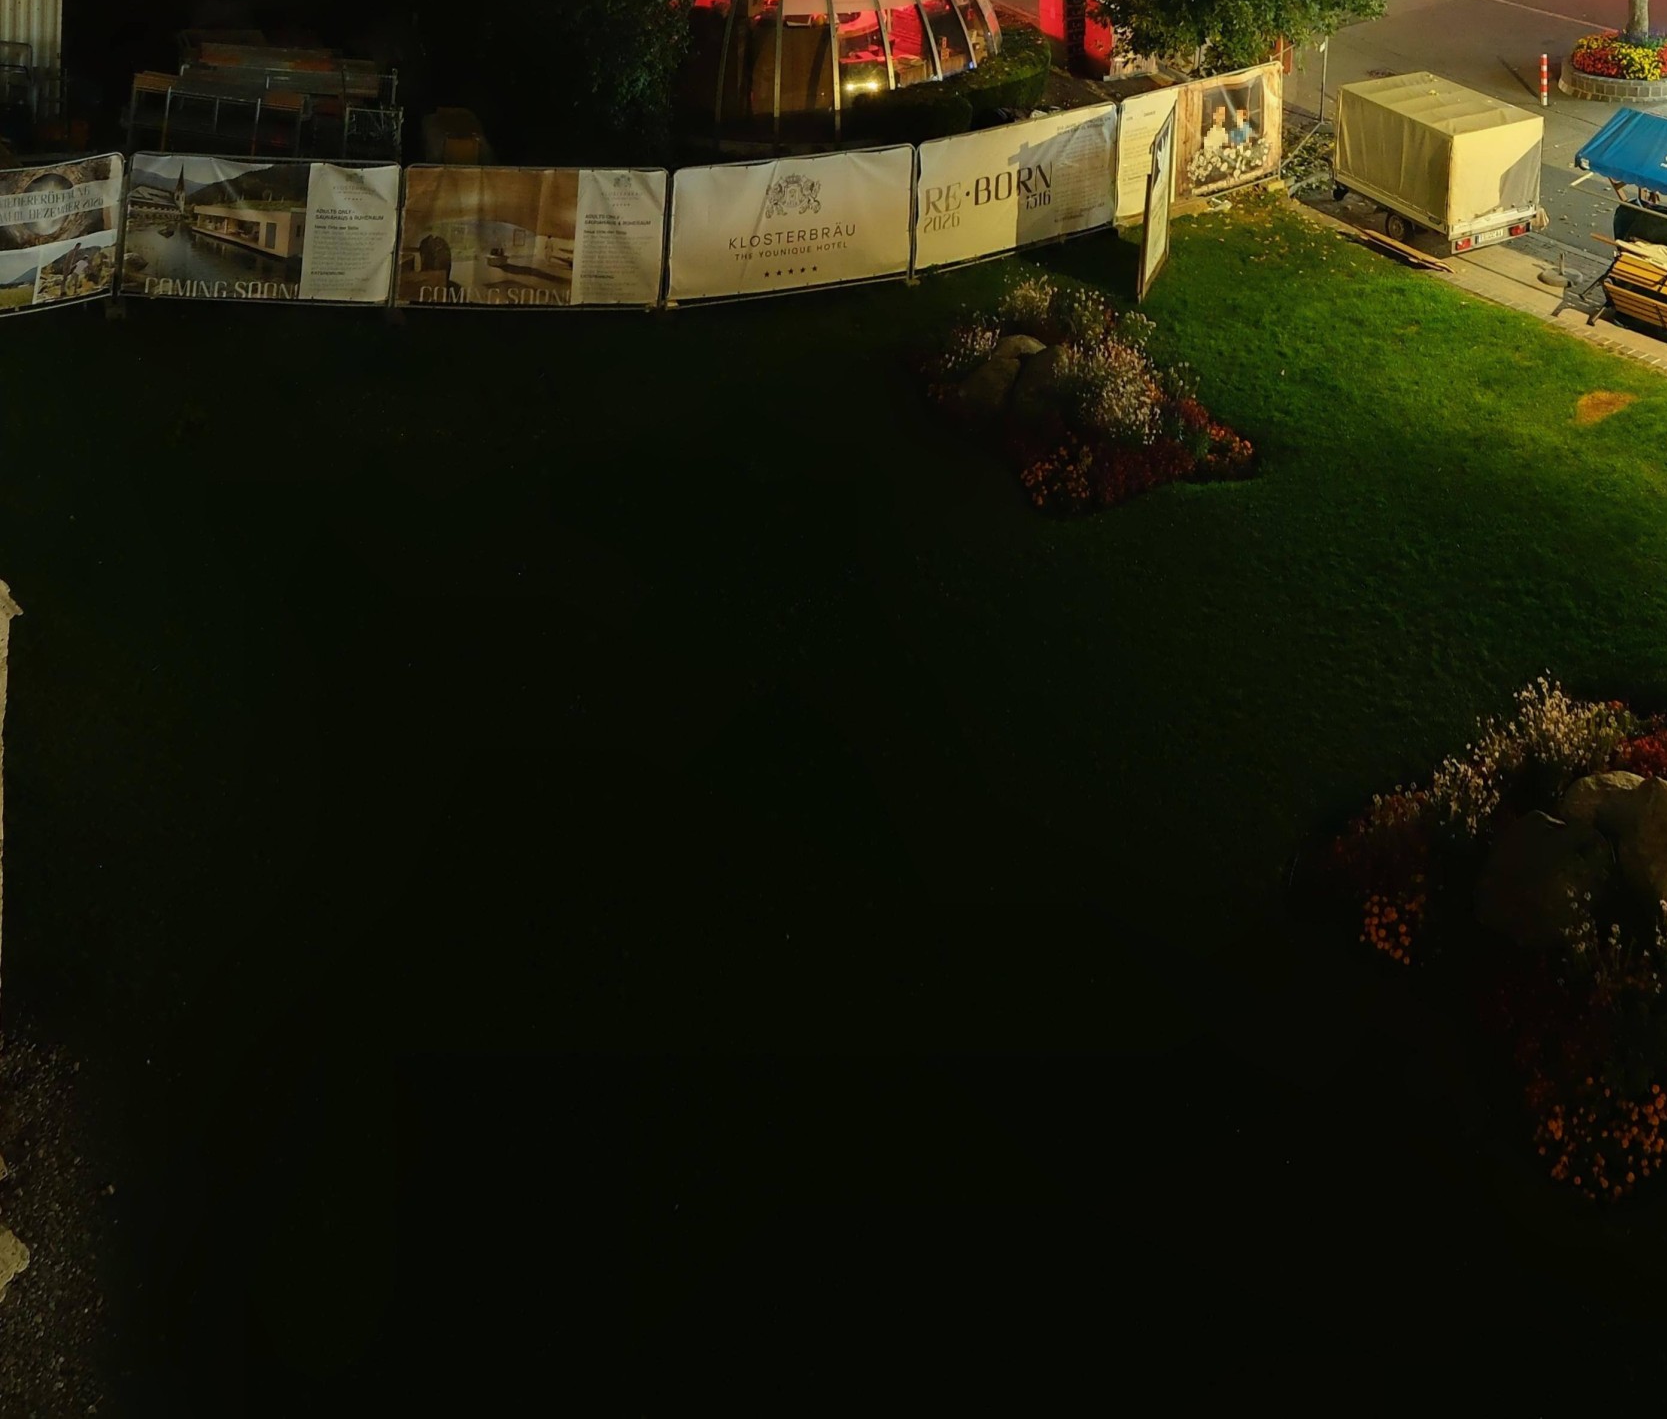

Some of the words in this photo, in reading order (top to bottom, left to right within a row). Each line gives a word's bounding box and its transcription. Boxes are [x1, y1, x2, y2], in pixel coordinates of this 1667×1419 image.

[924, 213, 960, 234] 2026
[728, 222, 856, 250] KLOSTERBRÄU
[735, 252, 753, 261] THE
[758, 245, 812, 259] YOUNIQUE
[816, 241, 848, 251] HOTEL
[145, 277, 228, 299] COMING
[233, 278, 300, 300] SOON!
[419, 285, 500, 304] COMING
